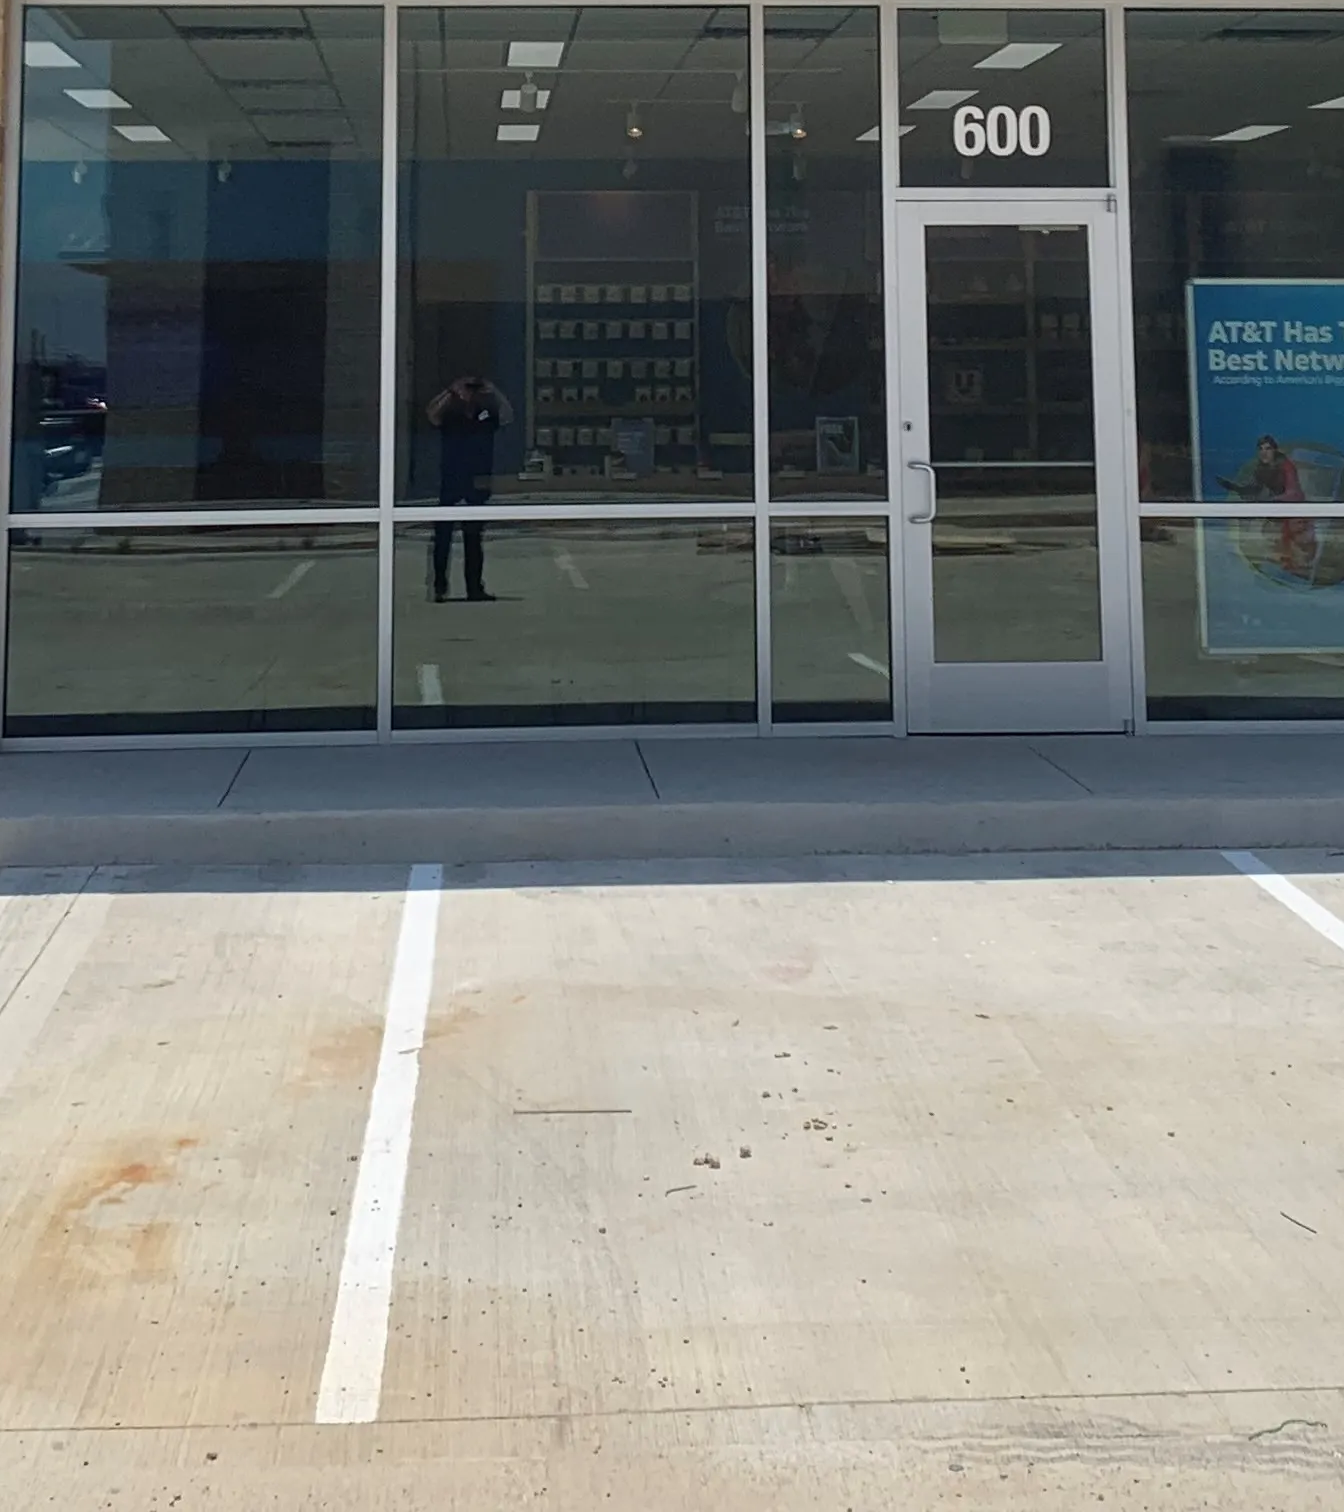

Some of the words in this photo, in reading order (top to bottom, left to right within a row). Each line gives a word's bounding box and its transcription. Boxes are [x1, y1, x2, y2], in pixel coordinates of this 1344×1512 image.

[953, 105, 1051, 156] 600
[1208, 320, 1277, 343] AT&T
[1284, 321, 1333, 343] Has
[1208, 349, 1269, 371] Best
